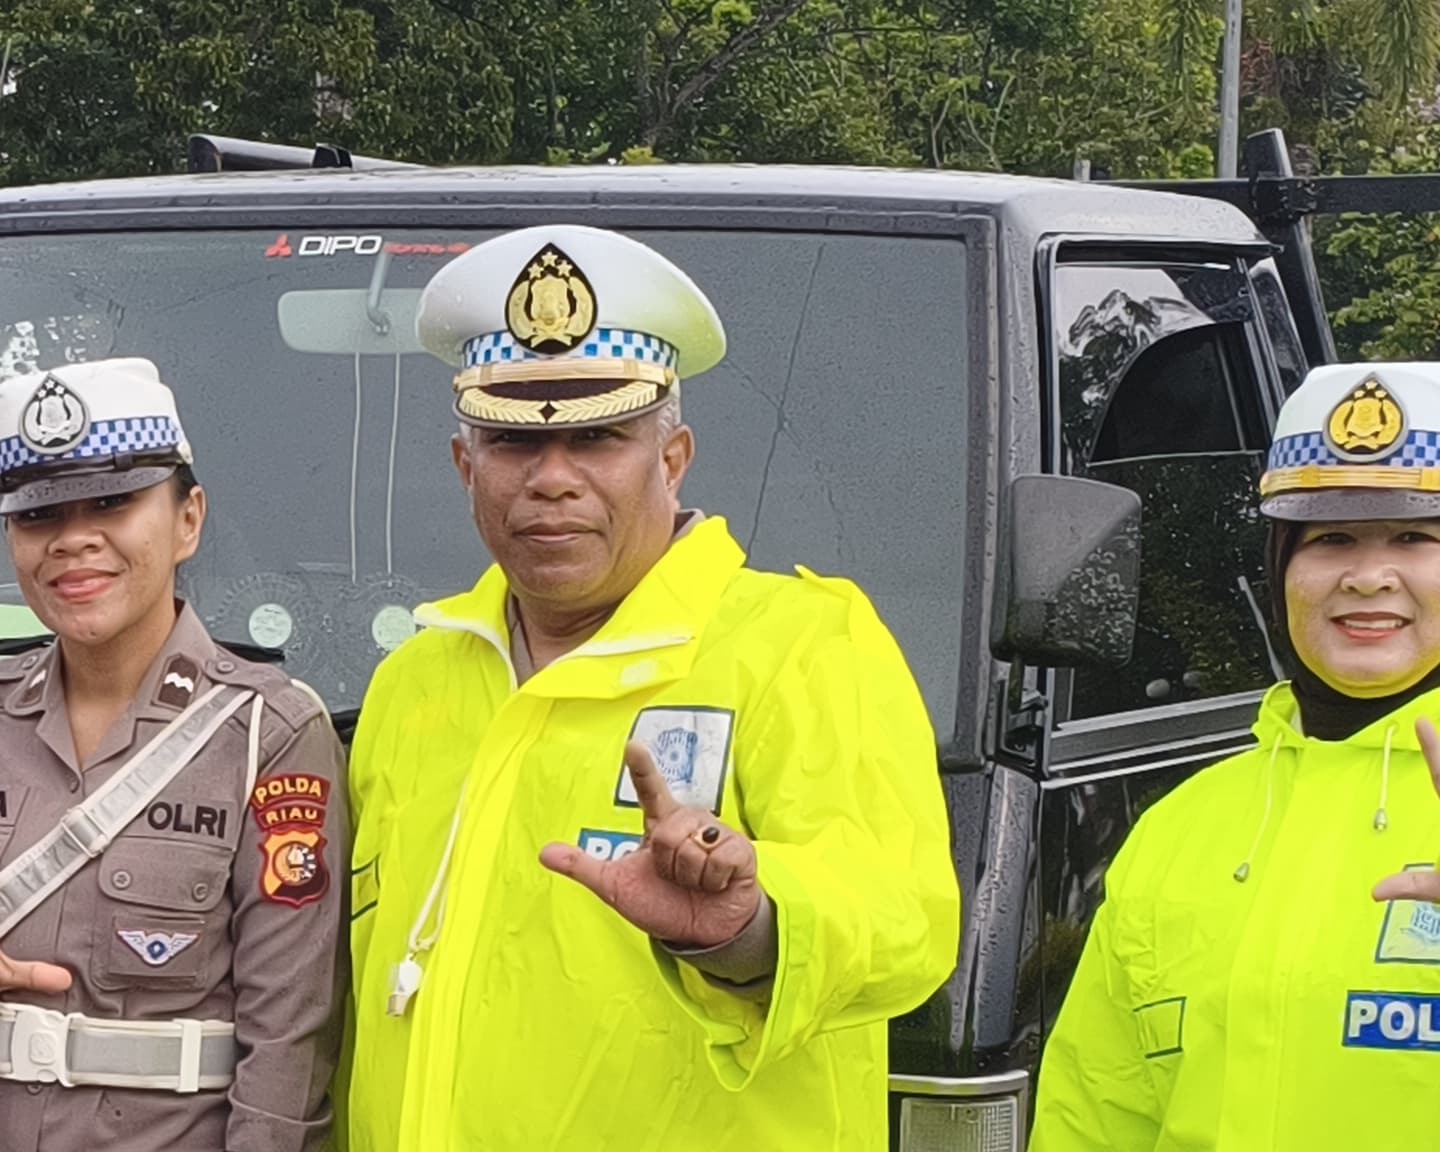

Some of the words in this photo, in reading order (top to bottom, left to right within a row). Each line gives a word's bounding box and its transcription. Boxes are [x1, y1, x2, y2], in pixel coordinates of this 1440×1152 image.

[298, 236, 382, 256] DIPO
[255, 778, 322, 804] POLDA
[138, 801, 228, 839] OLRI
[265, 807, 318, 824] RIAU
[1347, 1000, 1440, 1043] POL
